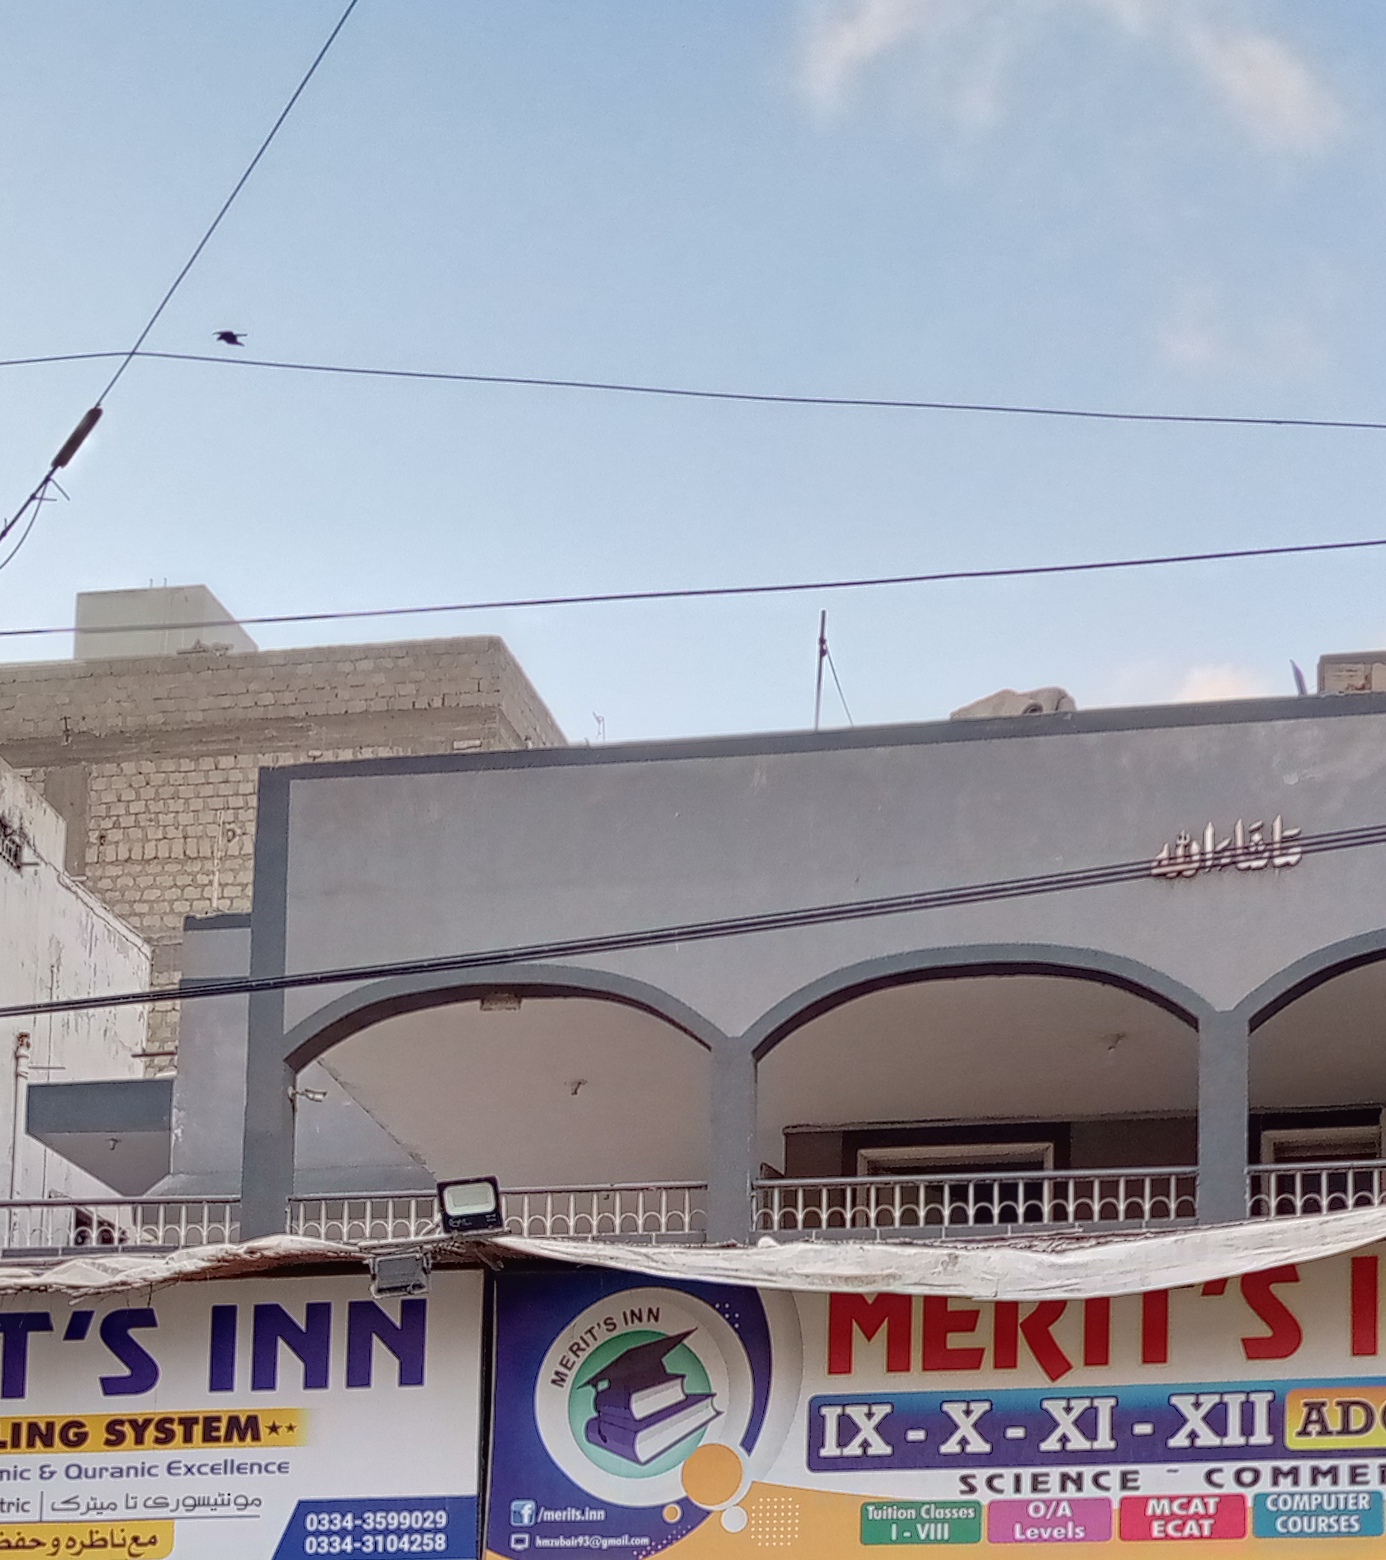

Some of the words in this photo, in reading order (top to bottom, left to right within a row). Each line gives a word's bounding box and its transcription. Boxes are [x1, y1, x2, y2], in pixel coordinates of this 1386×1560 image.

[209, 1299, 427, 1392] INN
[549, 1317, 618, 1388] MERIT'S
[622, 1306, 662, 1329] INN
[103, 1414, 261, 1447] SYSTEM
[819, 1402, 893, 1458] IX
[939, 1399, 993, 1455] X
[1039, 1395, 1117, 1452] XI
[1167, 1390, 1275, 1450] XII
[39, 1463, 57, 1480] &
[64, 1459, 160, 1481] Quranic
[166, 1458, 291, 1477] Excellence
[959, 1468, 1141, 1496] SCIENCE
[867, 1504, 916, 1522] Tuition
[920, 1502, 975, 1521] Classes
[1027, 1499, 1073, 1518] O/A
[1145, 1496, 1220, 1517] MCAT
[1265, 1492, 1370, 1512] COMPUTER
[305, 1510, 448, 1531] 0334-3599029
[1150, 1517, 1214, 1538] ECAT
[1275, 1513, 1362, 1535] COURSES
[916, 1522, 950, 1541] VIII
[1013, 1522, 1085, 1542] Levels
[304, 1533, 448, 1555] 0334-3104258
